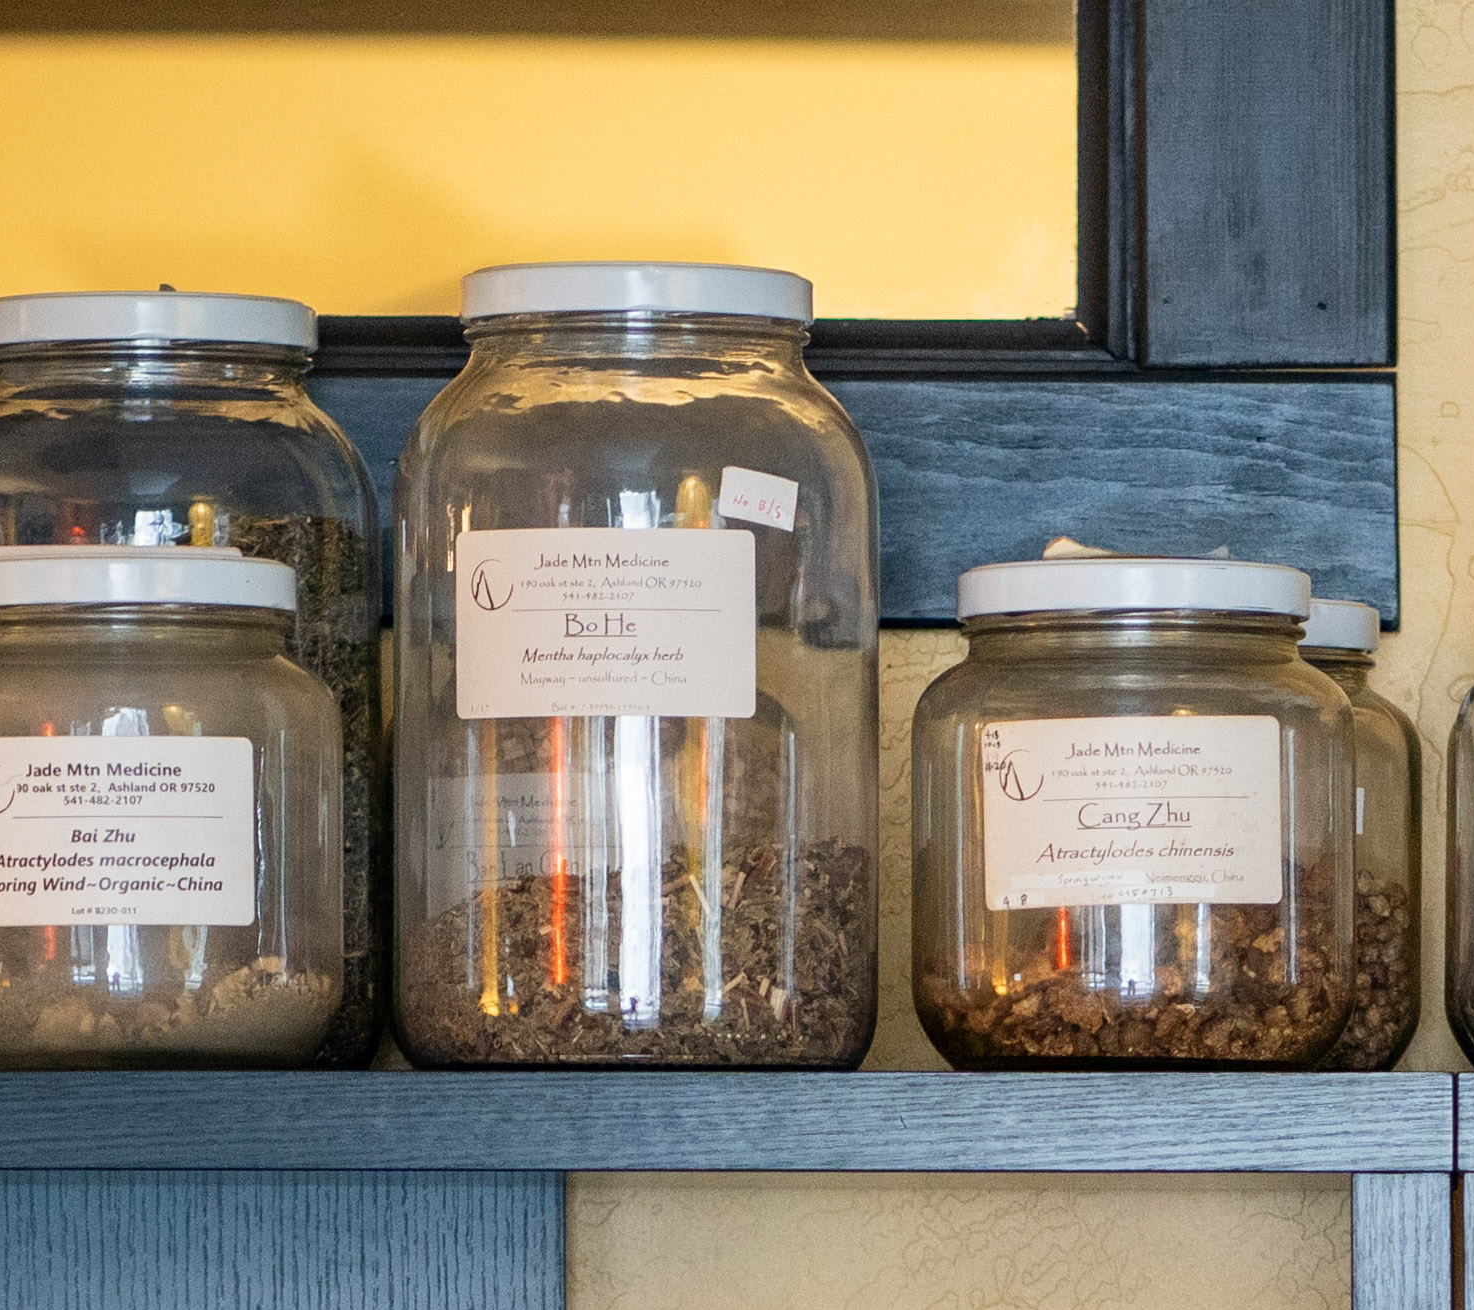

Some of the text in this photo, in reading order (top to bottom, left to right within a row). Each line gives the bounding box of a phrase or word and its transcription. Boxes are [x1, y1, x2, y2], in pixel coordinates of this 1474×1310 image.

[564, 612, 636, 634] Bo He
[522, 647, 683, 666] Mentha haplocalyx herb
[64, 796, 142, 805] 541-482-2107
[1077, 802, 1191, 829] Cang Zhu
[71, 829, 135, 843] Bai Zhu
[100, 853, 215, 870] macrocephala
